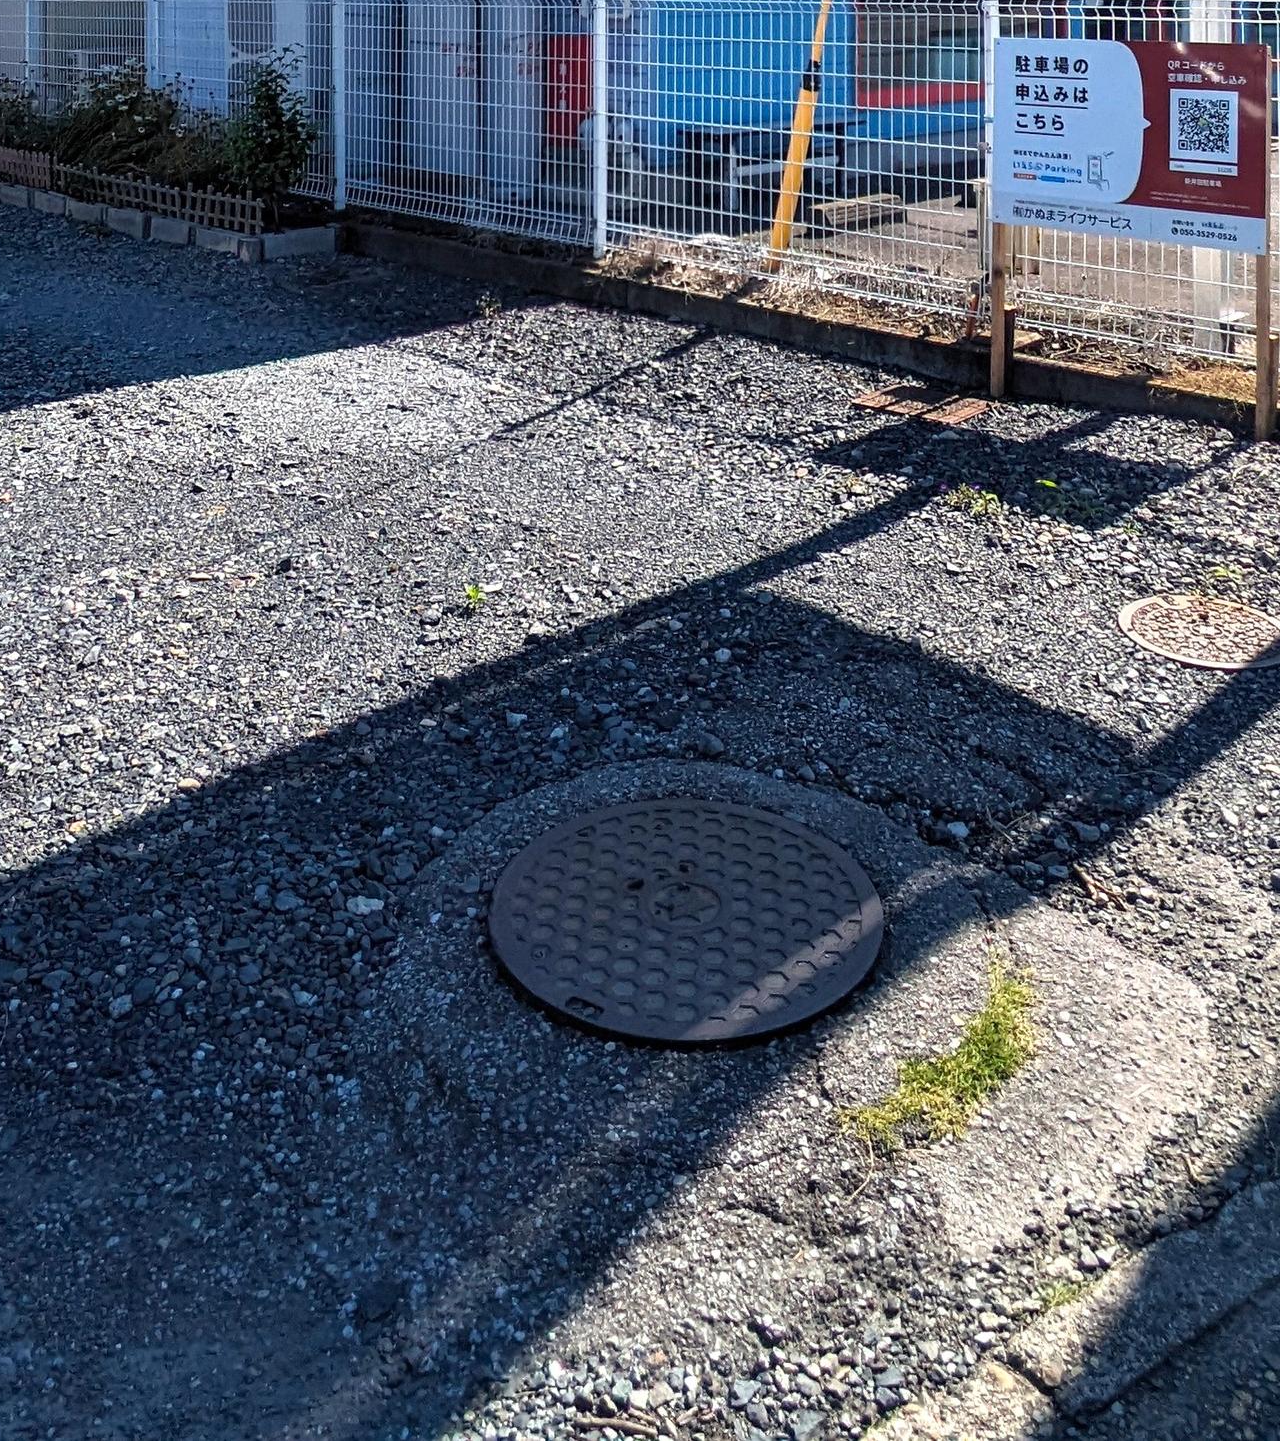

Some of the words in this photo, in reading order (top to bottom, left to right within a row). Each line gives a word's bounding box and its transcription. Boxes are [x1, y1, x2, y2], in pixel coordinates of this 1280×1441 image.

[1015, 55, 1089, 75] 駐車場の
[1015, 83, 1089, 104] 申込みは
[1016, 113, 1065, 131] こちら
